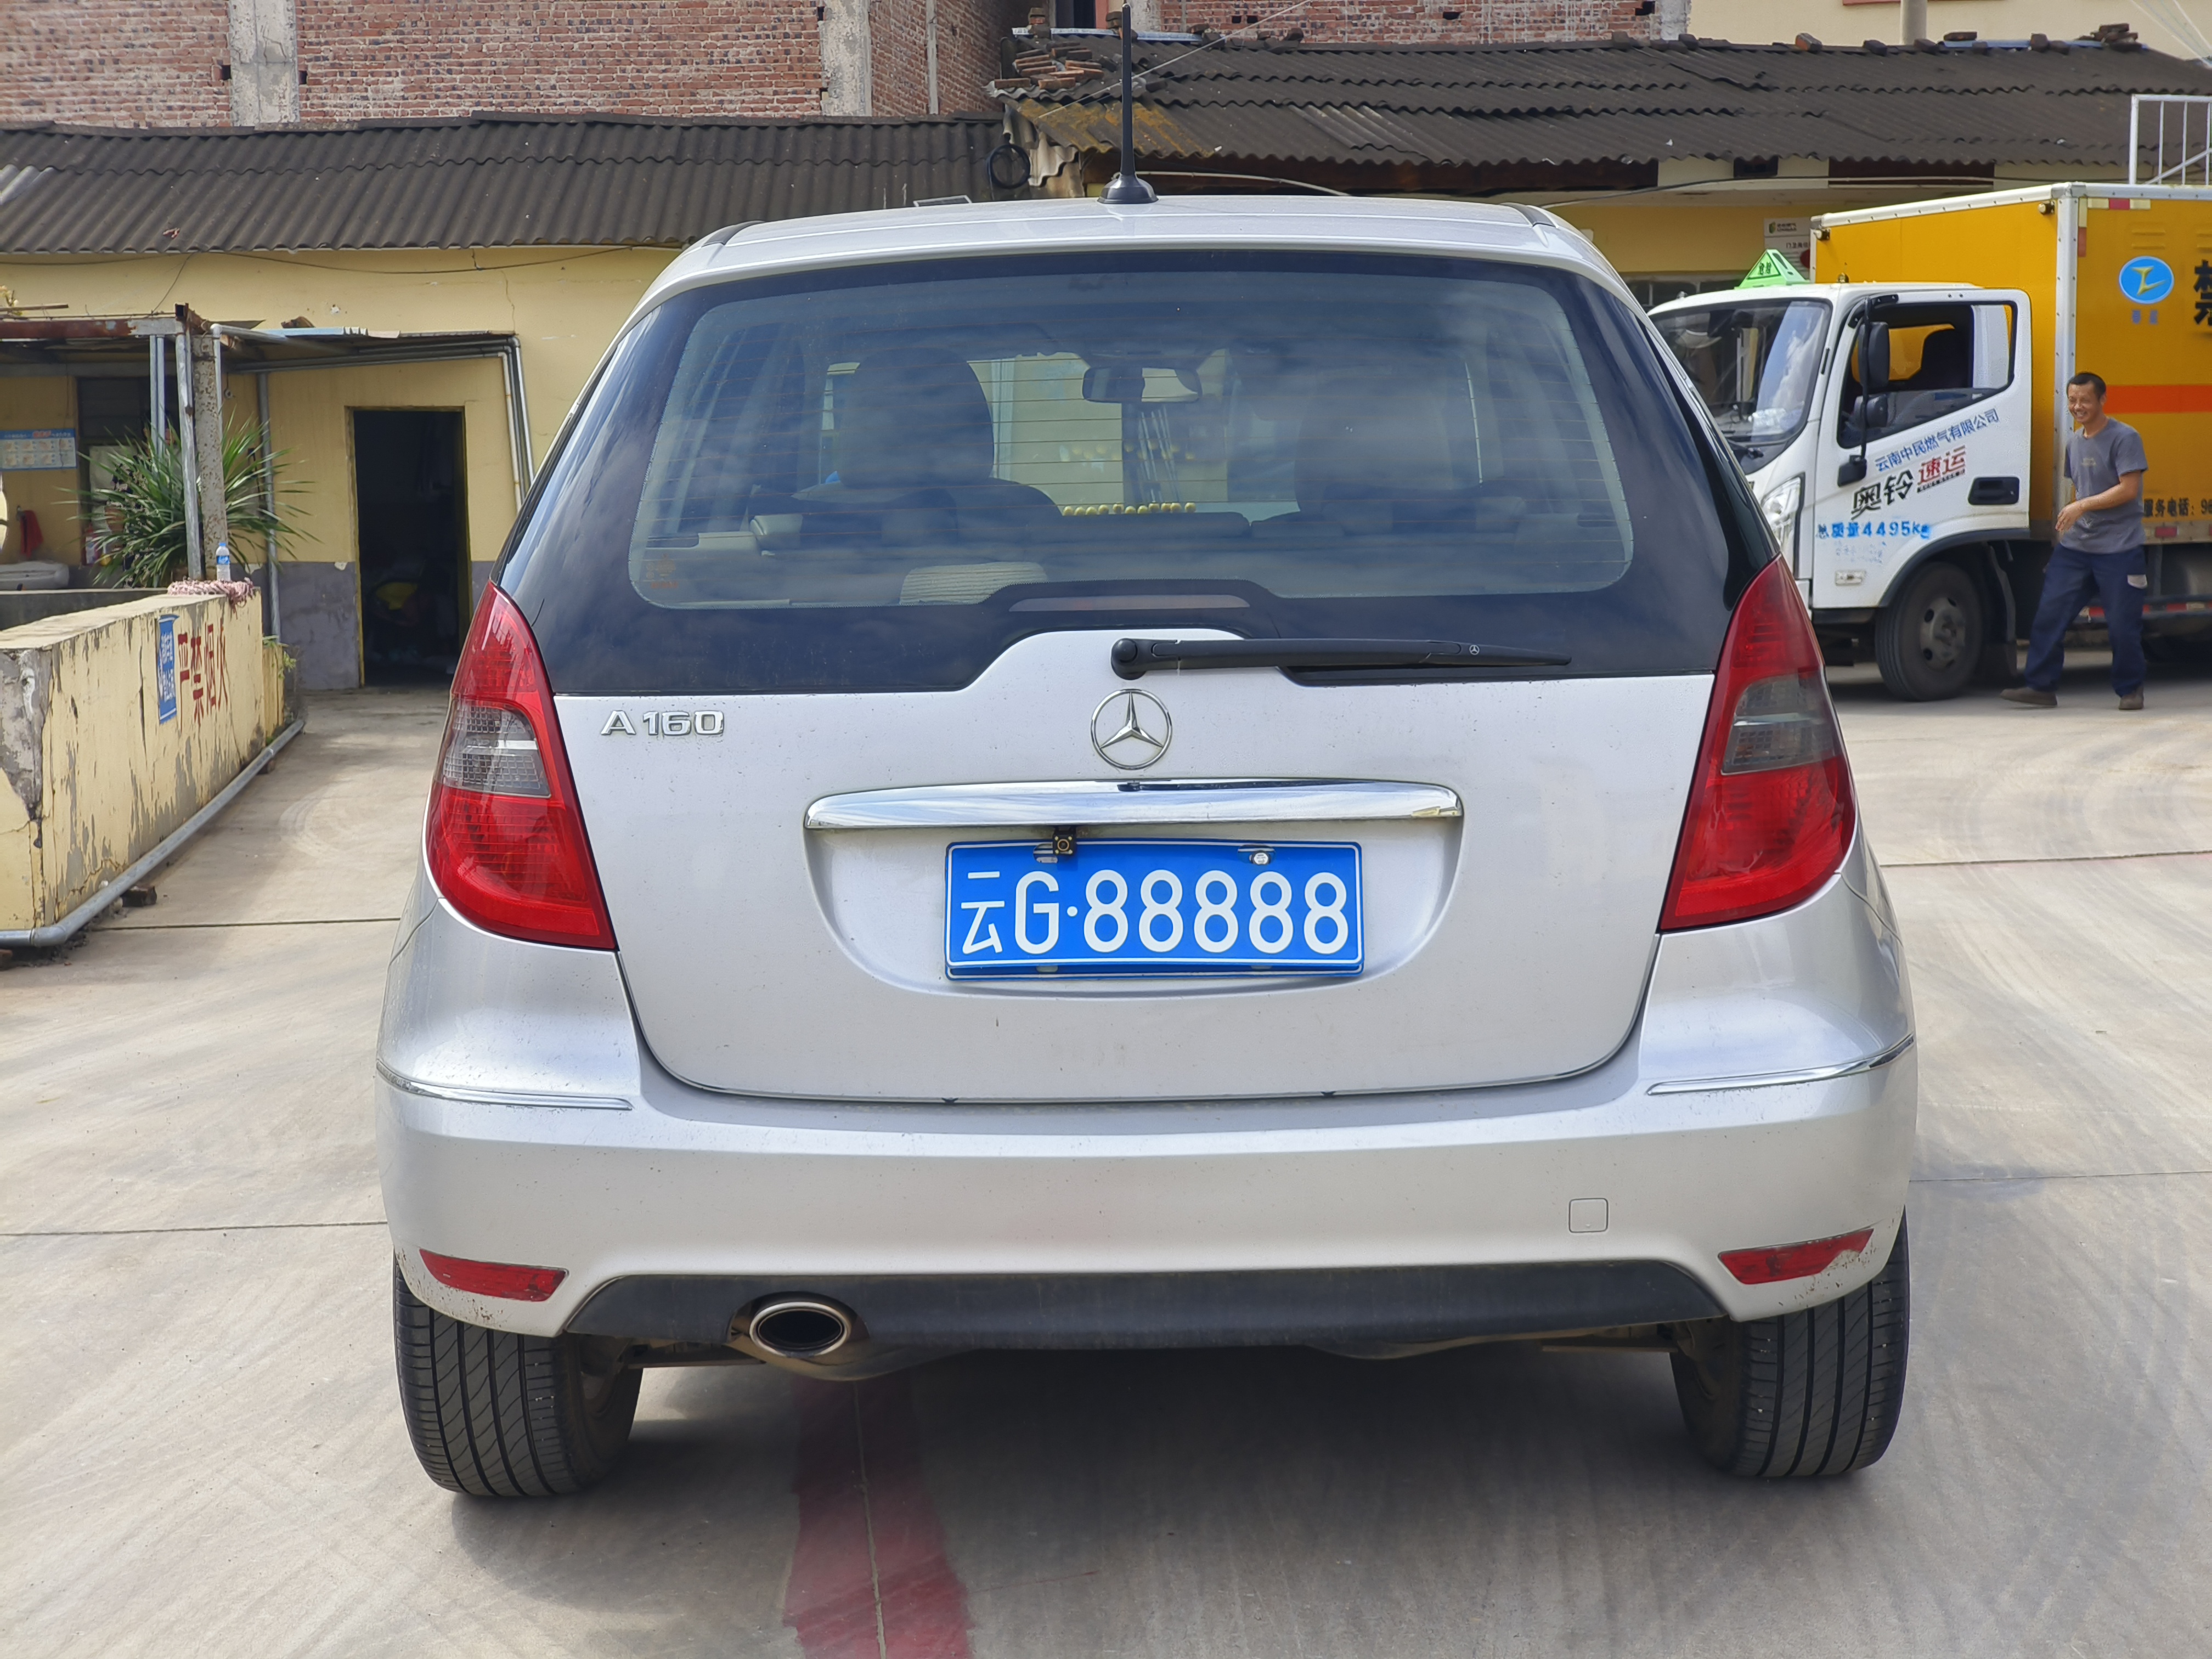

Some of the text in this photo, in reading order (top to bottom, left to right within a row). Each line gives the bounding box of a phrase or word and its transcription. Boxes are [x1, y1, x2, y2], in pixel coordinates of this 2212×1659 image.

[1875, 408, 2000, 472] 云南中民燃气有限公司
